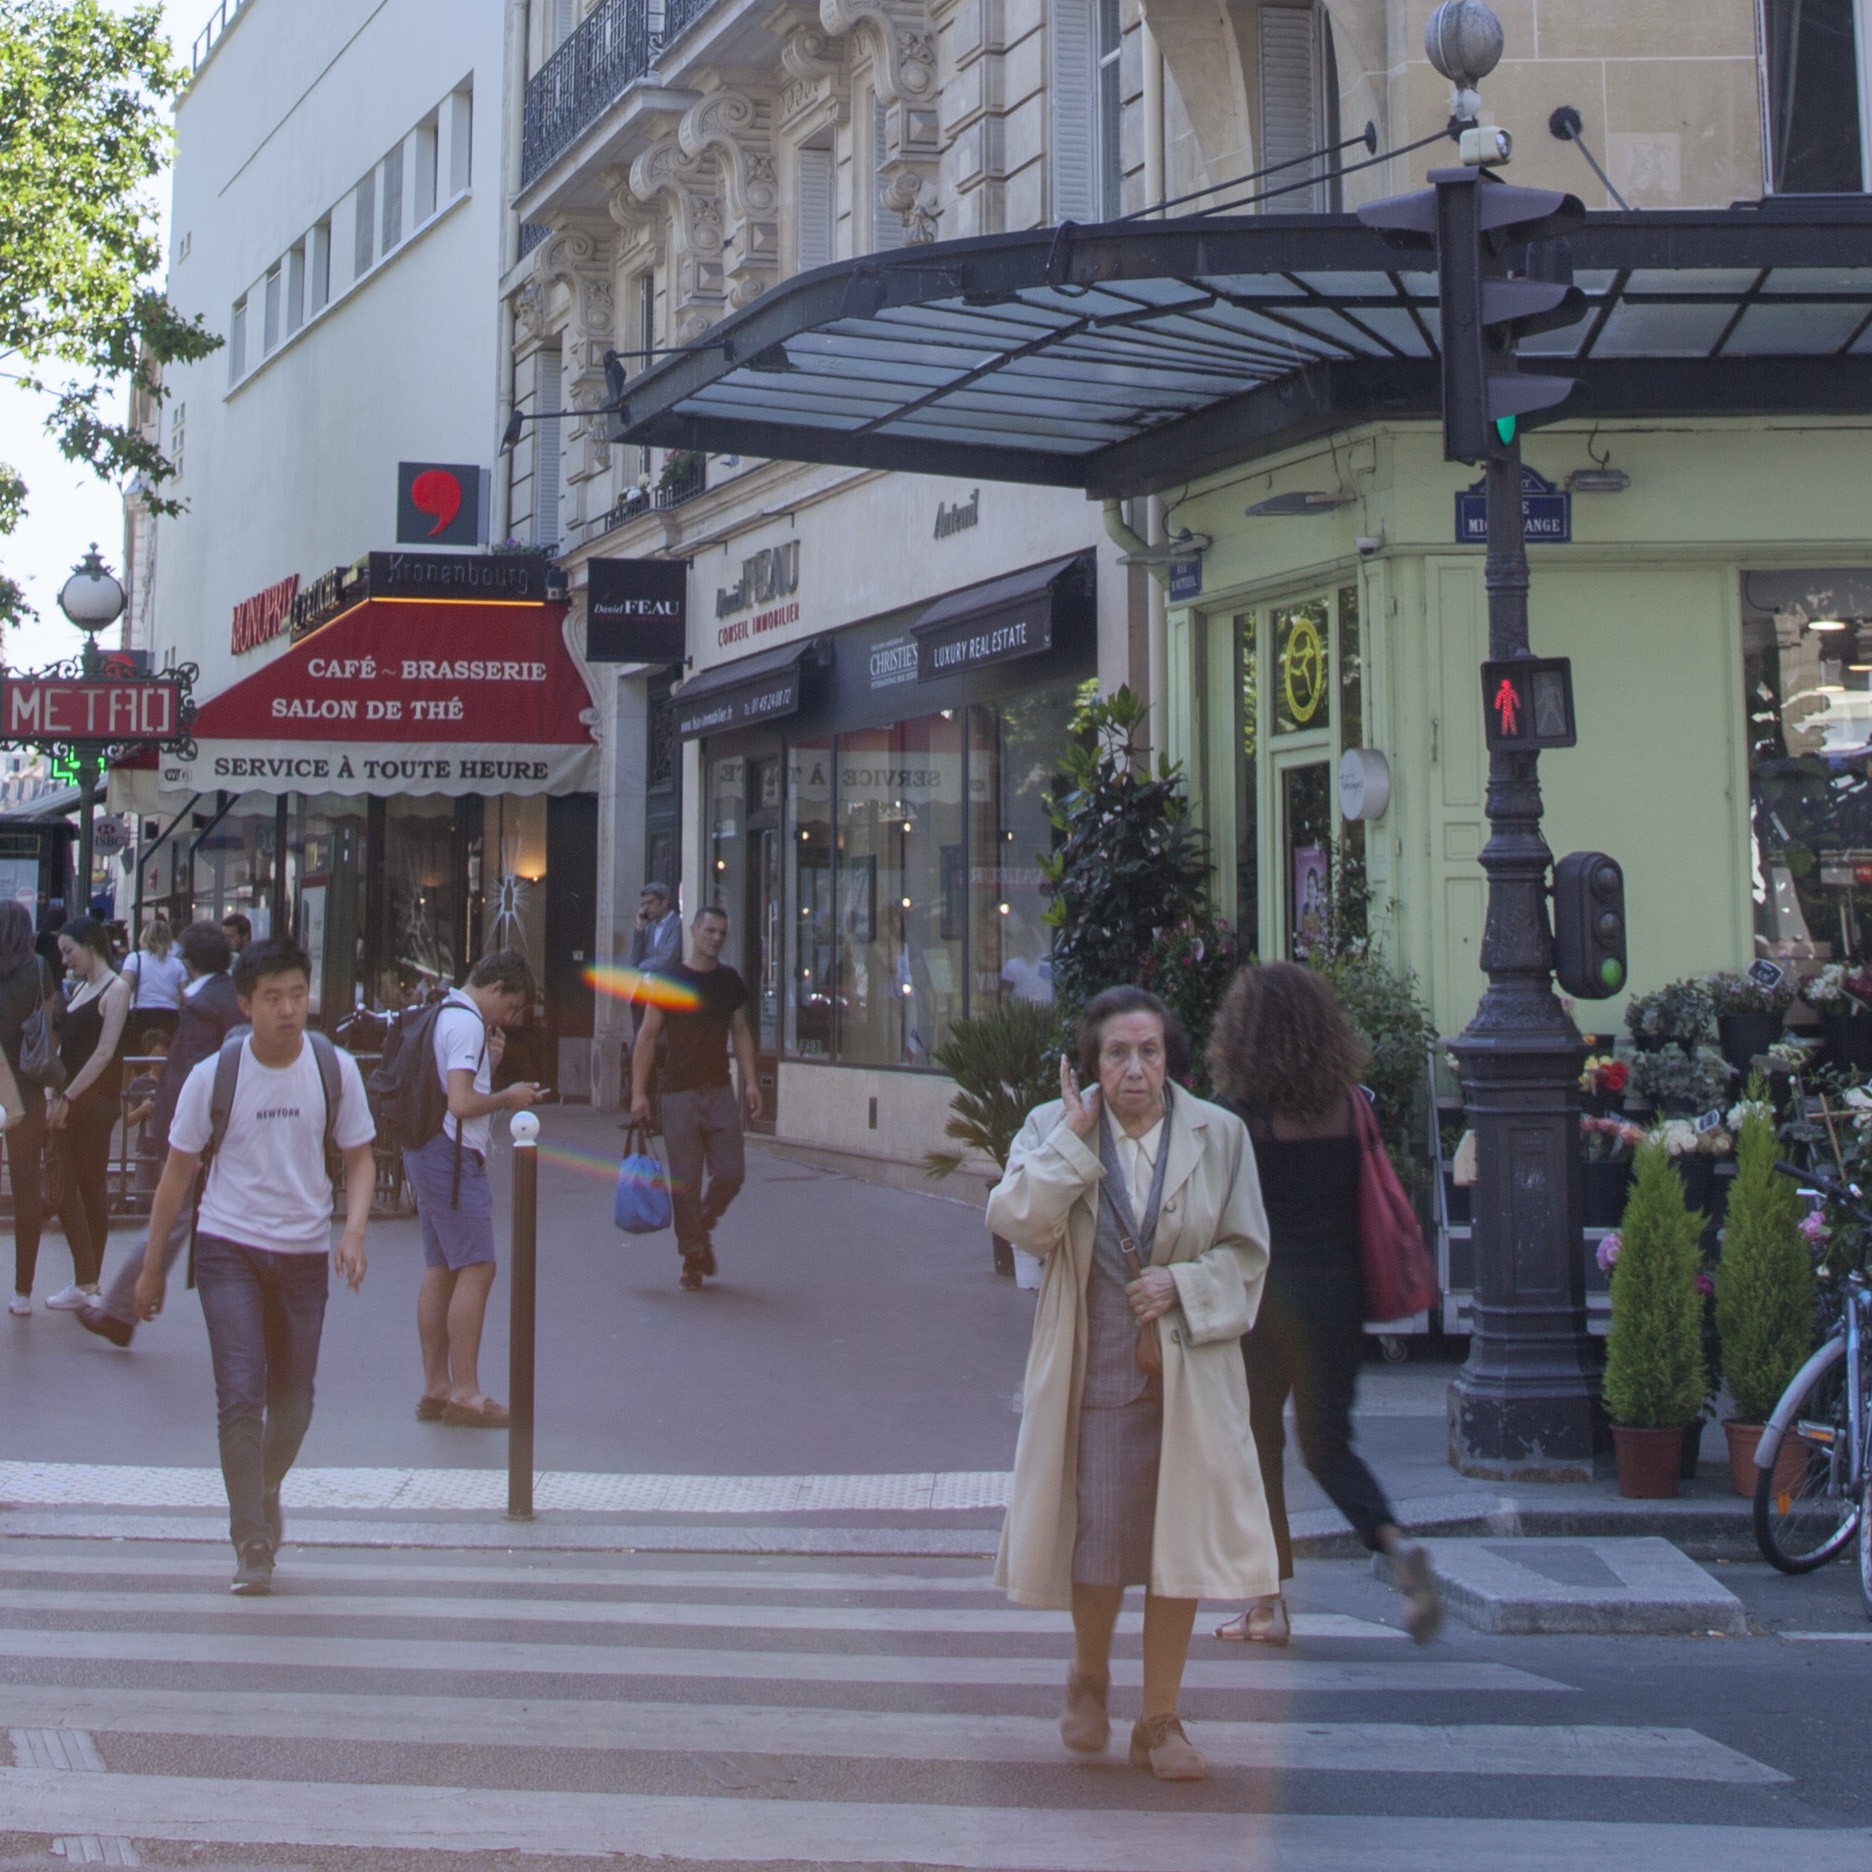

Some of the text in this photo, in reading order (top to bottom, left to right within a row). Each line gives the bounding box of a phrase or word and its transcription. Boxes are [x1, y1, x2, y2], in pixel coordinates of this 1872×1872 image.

[388, 554, 529, 594] Kronenbourg
[594, 599, 680, 616] Daniel FEAU
[717, 602, 801, 648] CONSEIL IMMOBILIER
[933, 639, 968, 668] LUXURY
[968, 635, 990, 659] REAL
[991, 622, 1028, 652] ESTATE
[307, 655, 547, 682] CAFÉ BRASSERIE
[11, 687, 170, 732] METRO
[271, 696, 464, 720] SALON DE THÉ
[214, 755, 549, 781] SERVICE À TOUTE HEURE
